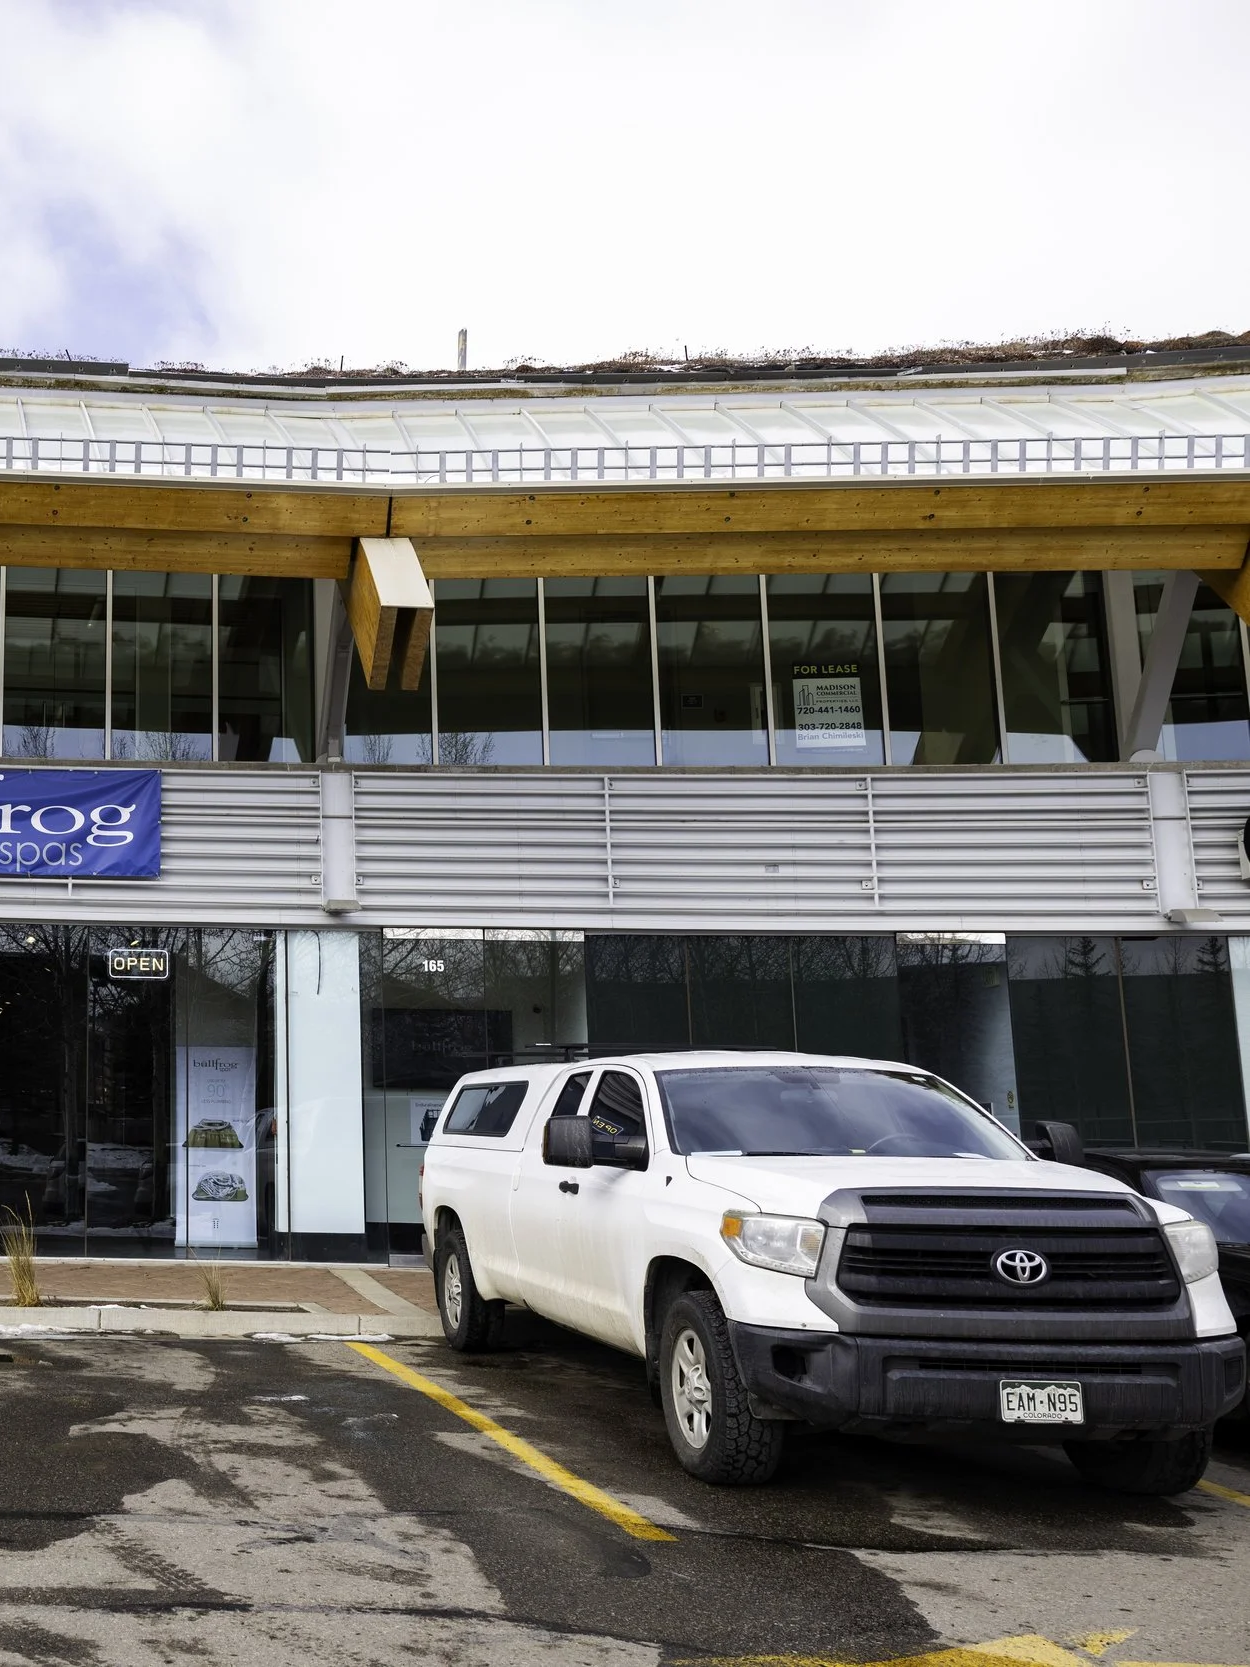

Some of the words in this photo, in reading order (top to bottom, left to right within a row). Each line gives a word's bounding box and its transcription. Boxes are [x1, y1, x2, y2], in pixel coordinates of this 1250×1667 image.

[793, 665, 818, 675] FOR
[822, 664, 858, 674] LEASE
[816, 683, 856, 691] MADISON
[797, 705, 861, 715] 720-441-1460
[798, 721, 862, 731] 303-720-2848
[798, 733, 819, 741] Brian
[822, 731, 864, 740] Chimileski
[113, 956, 164, 972] OPEN
[422, 959, 445, 972] 165
[193, 1058, 238, 1070] bullfrog
